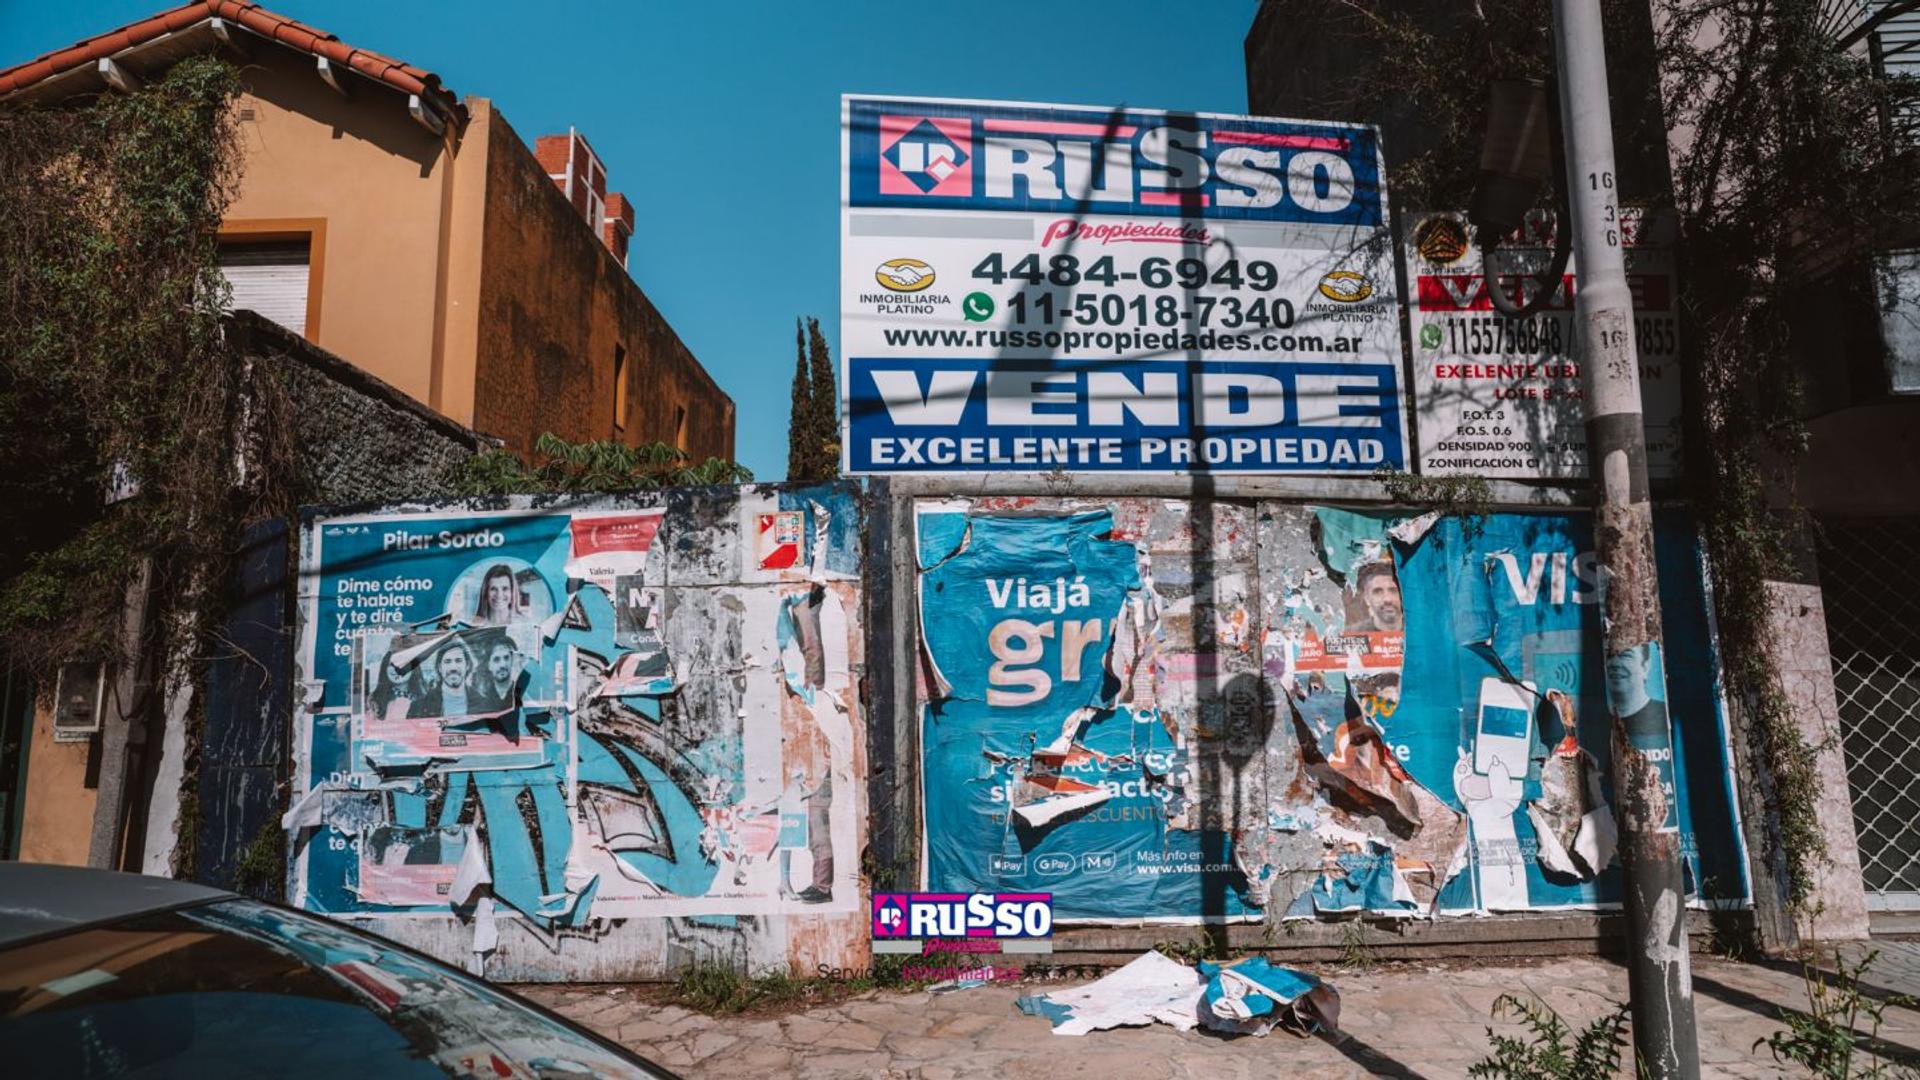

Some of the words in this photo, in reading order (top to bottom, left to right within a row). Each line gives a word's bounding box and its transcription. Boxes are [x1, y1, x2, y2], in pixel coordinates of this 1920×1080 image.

[984, 126, 1355, 213] RUSSO
[1589, 172, 1613, 191] 16
[1605, 206, 1615, 222] 3
[1041, 218, 1213, 248] Propiedades
[1606, 230, 1617, 247] 6
[971, 252, 1279, 292] 4484-6949
[859, 294, 951, 304] INMOBILIARIA
[877, 305, 935, 314] PLATINO
[1007, 291, 1295, 329] 11-5018-7340
[1305, 303, 1388, 314] INMOBILIARIA
[1322, 313, 1374, 324] PLATINO
[884, 328, 1363, 353] www.russopropiedades.com.ar
[1449, 318, 1561, 355] 1155756848
[1436, 364, 1536, 380] EXELENTE
[870, 370, 1382, 427] VENDE
[1495, 388, 1537, 401] LOTE
[1496, 411, 1505, 420] 3
[1492, 426, 1511, 436] 0.6
[870, 438, 1123, 464] EXCELENTE
[1140, 438, 1384, 464] PROPIEDAD
[1438, 441, 1505, 452] DENSIDAD
[1508, 441, 1531, 451] 900
[1428, 455, 1522, 468] ZONIFICACIÓN
[384, 531, 433, 550] Pilar
[438, 530, 505, 549] Sordo
[589, 568, 615, 576] Valeria
[1498, 550, 1602, 605] VIS
[338, 578, 381, 593] Dime
[384, 576, 433, 591] cómo
[337, 595, 353, 608] te
[357, 593, 414, 607] hablas
[985, 576, 1091, 614] Viajá
[336, 614, 347, 628] y
[351, 611, 367, 624] te
[370, 609, 403, 623] diré
[334, 643, 351, 656] te
[986, 618, 1117, 707] gr
[329, 838, 346, 851] te
[1137, 851, 1160, 863] Más
[1163, 850, 1187, 861] info
[1190, 851, 1205, 860] en
[1003, 861, 1022, 872] Pay
[1052, 860, 1069, 871] Pay
